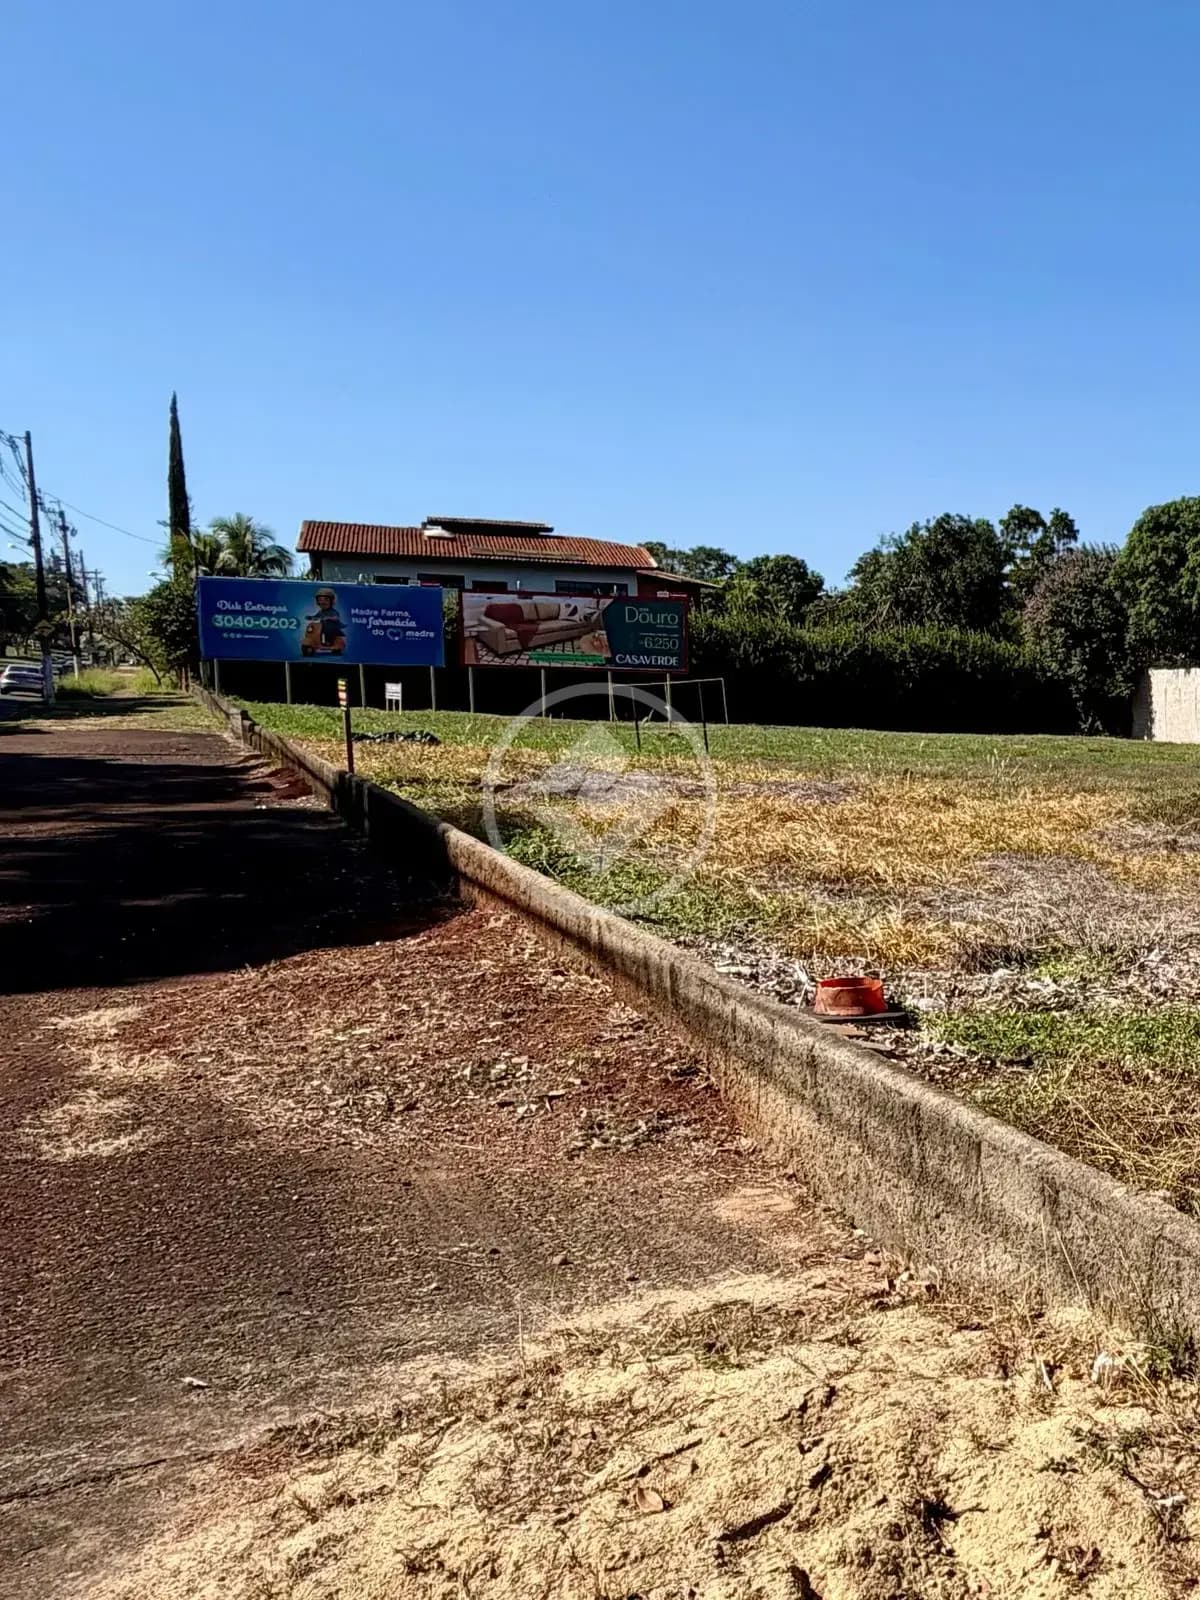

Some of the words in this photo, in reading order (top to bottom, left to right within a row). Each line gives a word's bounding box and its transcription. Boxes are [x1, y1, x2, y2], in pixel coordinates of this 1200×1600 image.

[244, 600, 288, 614] Entregas
[351, 608, 379, 616] Madre
[214, 614, 297, 629] 3040-0202
[625, 606, 679, 624] Douro
[367, 616, 417, 629] farmácia
[615, 654, 679, 666] CASAVERDE
